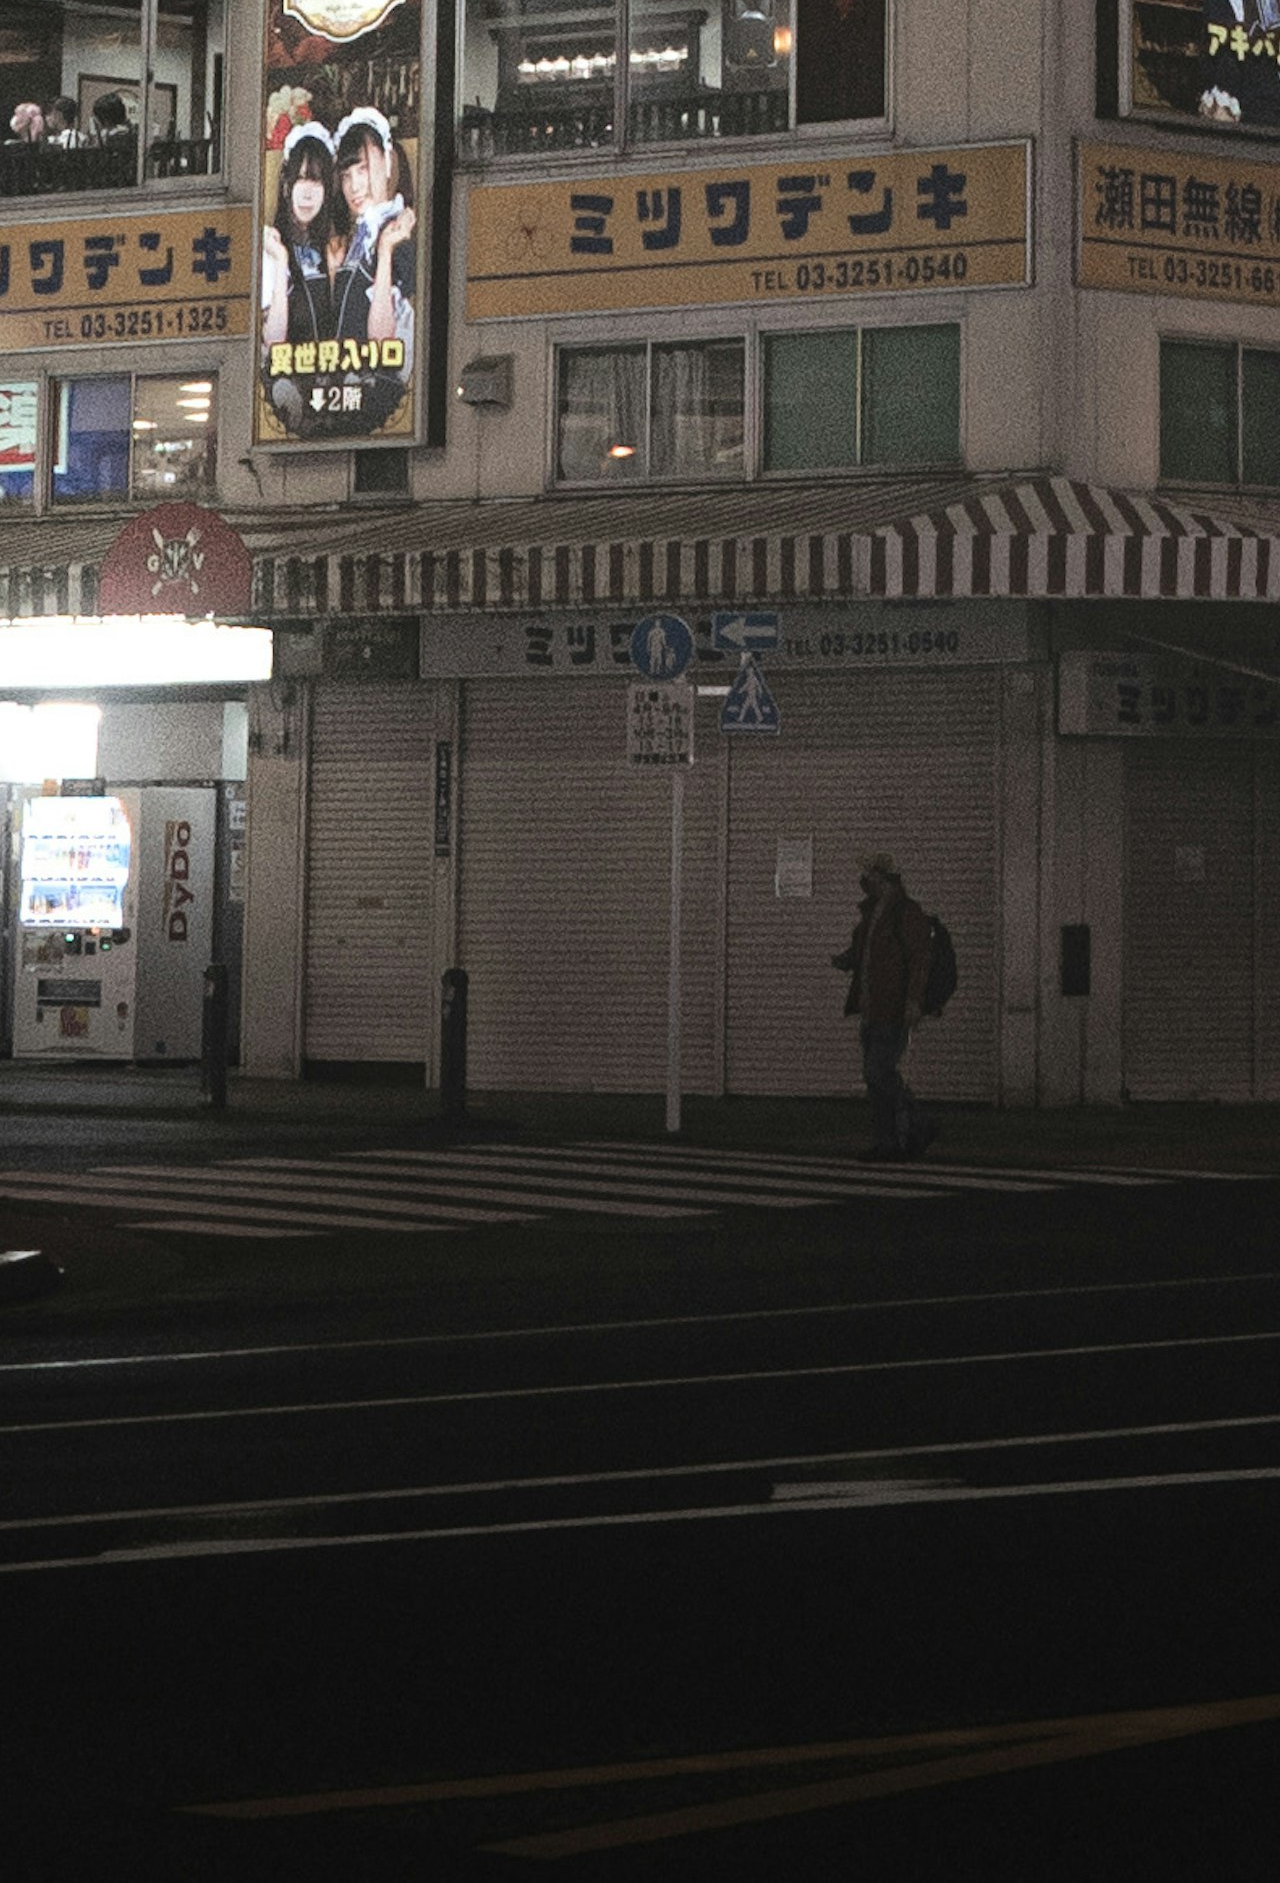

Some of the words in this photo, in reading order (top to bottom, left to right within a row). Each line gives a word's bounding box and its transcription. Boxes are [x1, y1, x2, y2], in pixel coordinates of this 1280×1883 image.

[569, 164, 969, 254] ミツワデンキ
[751, 271, 786, 291] TEL
[795, 254, 967, 291] 03-3251-0540
[1127, 257, 1158, 282] TEL
[44, 319, 72, 339] TEL
[80, 306, 228, 339] 03-3251-1325
[269, 338, 405, 377] 異世界入り口
[327, 386, 363, 412] 2階
